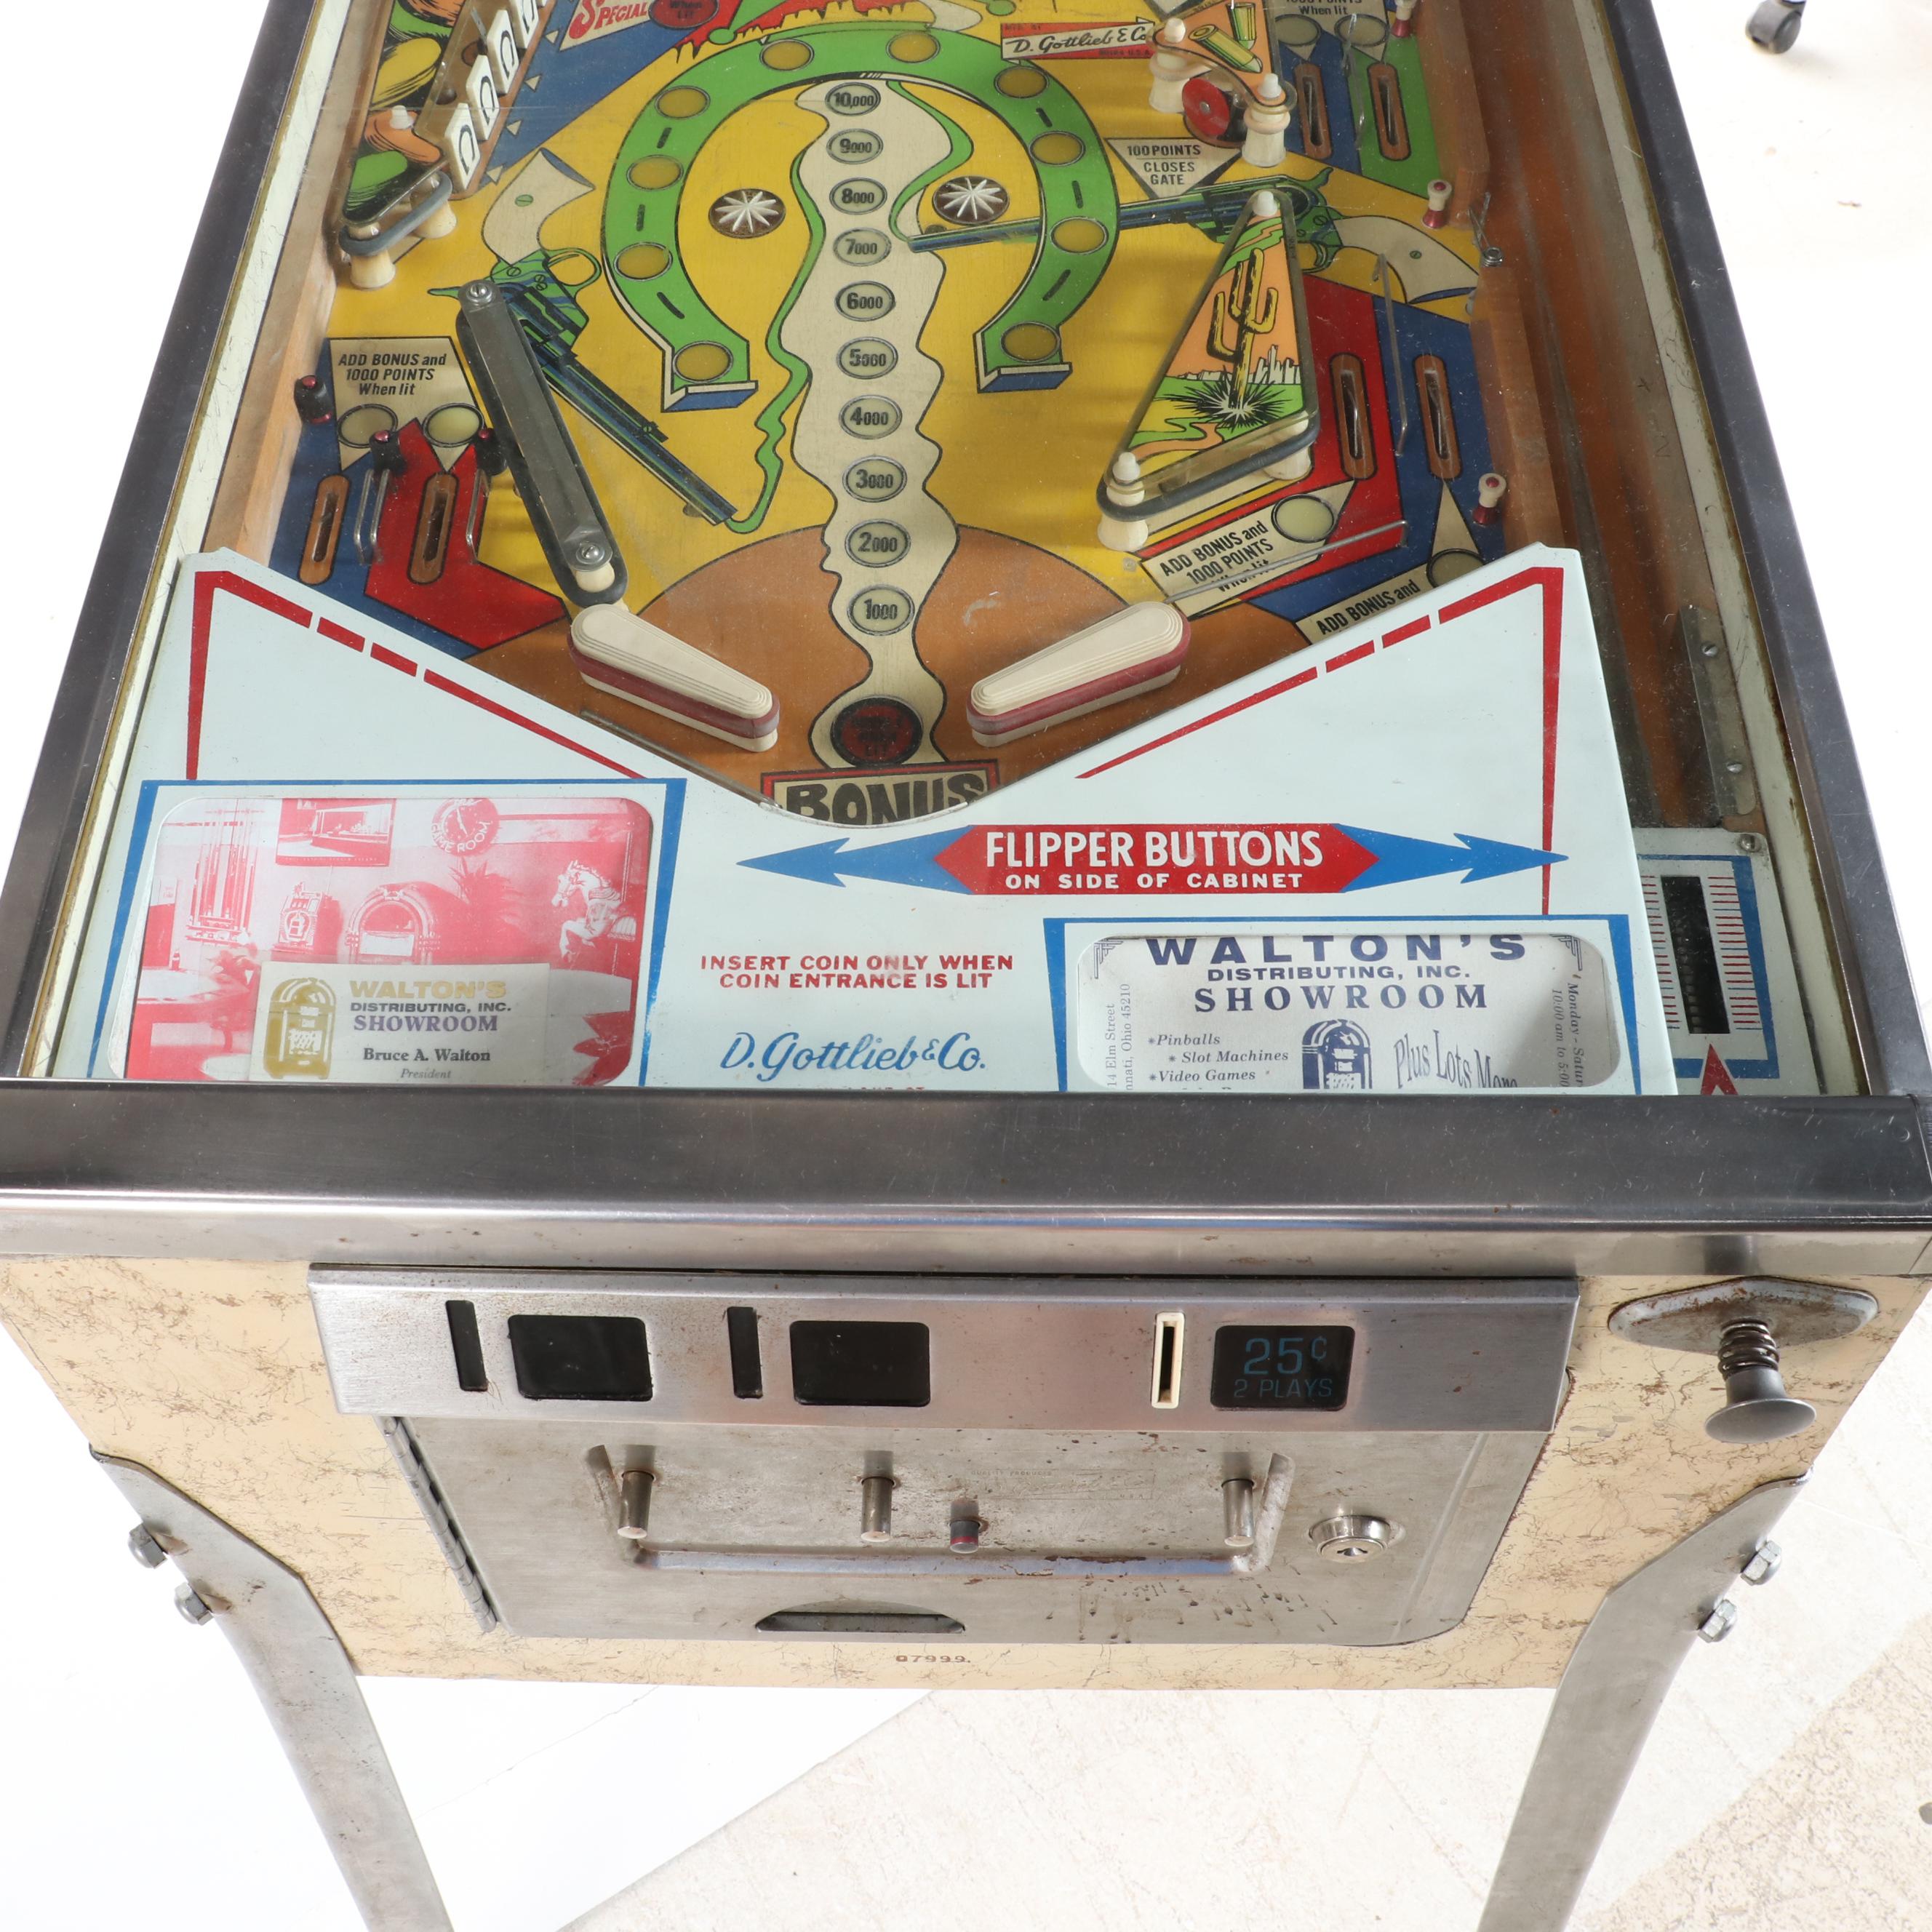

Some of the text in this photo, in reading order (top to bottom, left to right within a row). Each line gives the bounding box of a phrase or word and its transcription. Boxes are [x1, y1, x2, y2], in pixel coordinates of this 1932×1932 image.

[569, 0, 647, 39] SPECIAL
[1299, 6, 1331, 15] When
[1005, 39, 1034, 52] D.
[1038, 29, 1113, 53] Gottlieb
[834, 92, 874, 108] 10,000
[839, 138, 872, 153] 9000
[1127, 145, 1201, 156] 100 POINTS
[1143, 161, 1195, 172] CLOSES
[1150, 174, 1185, 185] GATE
[842, 188, 874, 204] 8000
[845, 239, 877, 255] 7000
[847, 292, 883, 310] 6000
[338, 353, 447, 366] ADD BONUS and
[849, 348, 887, 367] 5000
[346, 368, 435, 381] 1000 POINTS
[359, 383, 416, 396] When lit
[850, 407, 889, 426] 4000
[855, 469, 893, 489] 3000
[858, 532, 898, 553] 2000
[1159, 520, 1269, 577] ADD BONUS and
[1186, 563, 1224, 585] 1000
[1221, 538, 1274, 572] POINTS
[863, 599, 898, 620] 1000
[1316, 579, 1421, 635] ADD BONUS and
[786, 773, 983, 825] BONUS
[986, 831, 1322, 868] FLIPPER BUTTONS
[1005, 873, 1302, 889] ON SIDE OF CABINET
[1146, 934, 1525, 966] WALTON'S
[701, 954, 1013, 970] INSERT COIN ONLY WHEN
[720, 973, 993, 989] COIN ENTRANCE IS LIT
[1208, 965, 1470, 982] DISTRIBUTING, INC.
[349, 980, 507, 999] WALTON'S
[1194, 983, 1487, 1013] SHOWROOM
[350, 1002, 511, 1013] DISTRIBUTING, INC.
[1119, 983, 1132, 1018] 45210
[1552, 989, 1565, 1021] 10:00
[1567, 982, 1580, 1035] Monday
[354, 1015, 498, 1031] SHOWROOM
[1106, 1004, 1117, 1042] Street
[1554, 1023, 1564, 1042] am
[1121, 1023, 1133, 1052] Ohio
[1157, 1033, 1221, 1046] Pinballs
[363, 1047, 491, 1061] Bruce A. Walton
[720, 1031, 755, 1069] D.
[757, 1031, 919, 1082] Gottlieb
[938, 1031, 986, 1071] Co.
[1106, 1045, 1117, 1069] Elm
[1181, 1050, 1290, 1063] Slot Machines
[1394, 1033, 1431, 1089] Plus
[1432, 1029, 1472, 1088] Lots
[1557, 1047, 1567, 1058] to
[401, 1067, 452, 1079] President
[1159, 1070, 1256, 1082] Video Games
[1234, 1378, 1333, 1398] 2 PLAYS
